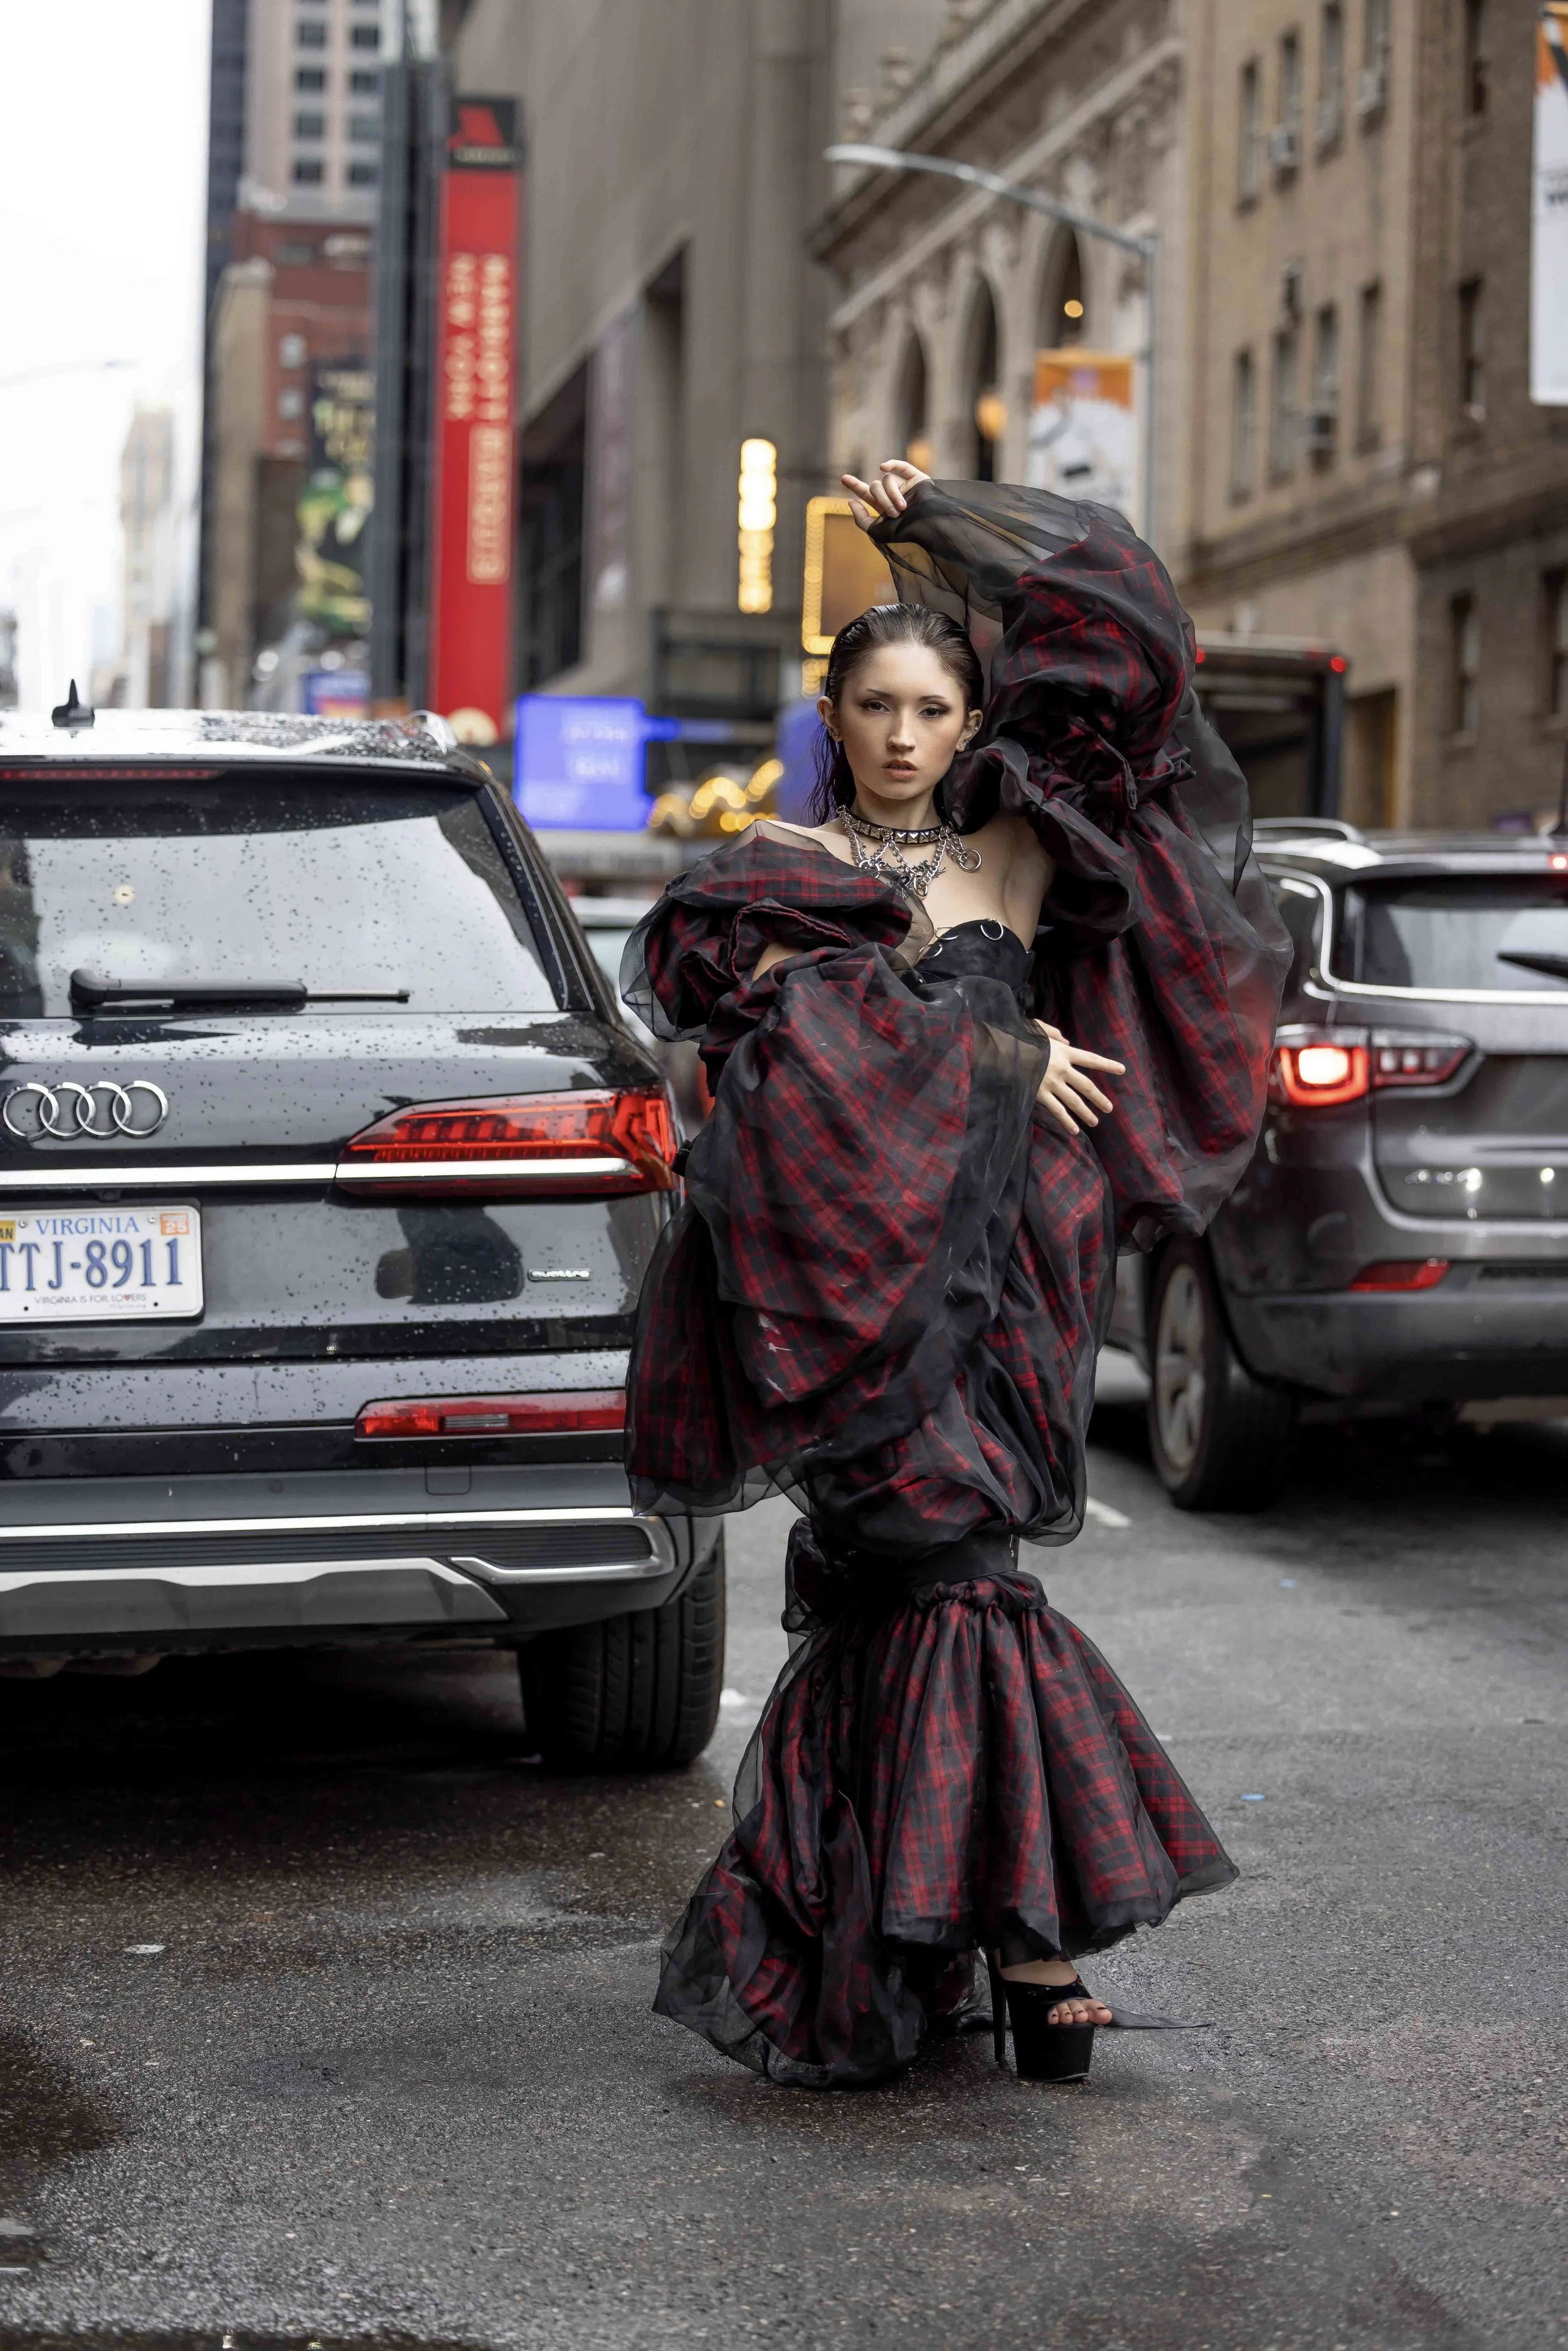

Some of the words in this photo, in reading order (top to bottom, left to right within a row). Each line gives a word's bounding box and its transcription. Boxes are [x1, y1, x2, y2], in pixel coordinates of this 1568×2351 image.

[35, 1216, 140, 1235] VIRGINIA
[34, 1295, 77, 1305] VIRGINIA
[80, 1295, 87, 1303] IS
[90, 1294, 109, 1303] FOR
